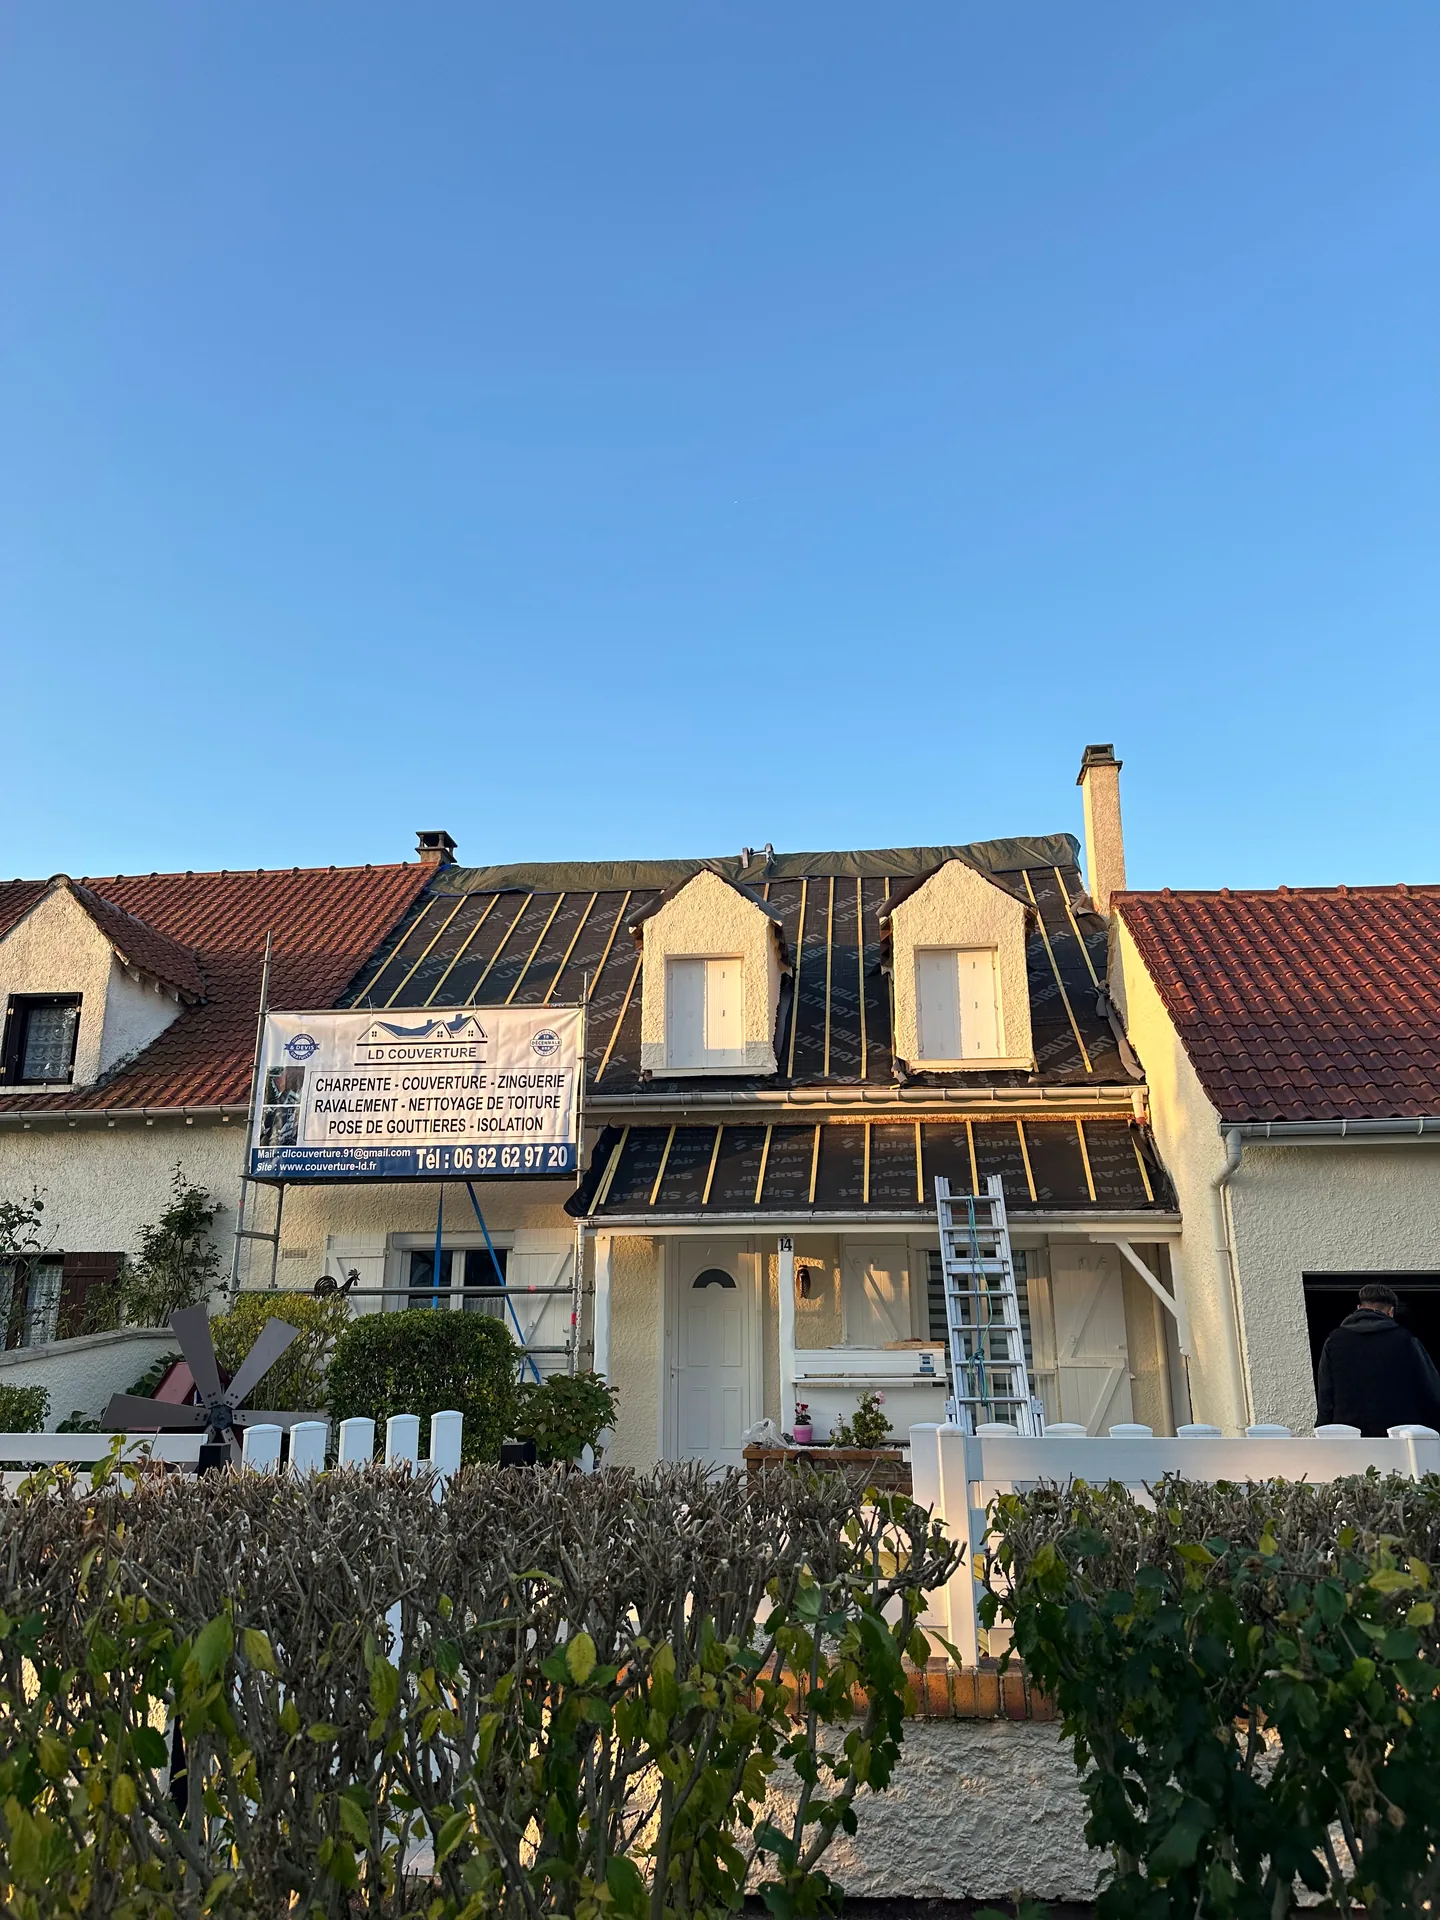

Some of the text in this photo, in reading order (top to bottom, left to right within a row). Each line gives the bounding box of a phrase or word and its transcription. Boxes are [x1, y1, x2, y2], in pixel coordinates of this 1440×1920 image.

[516, 909, 579, 935] ULTBAT
[809, 981, 879, 1009] UTIBAT
[368, 1047, 477, 1060] LD COUVERTURE
[1036, 1028, 1090, 1065] ULTIBA
[1050, 1035, 1117, 1075] ULTBAT
[315, 1077, 392, 1092] CHARPENTE
[402, 1075, 487, 1091] COUVERTURE
[497, 1074, 565, 1089] ZINGUERIE
[314, 1098, 399, 1113] RAVALEMENT
[408, 1097, 484, 1112] NETTOYAGE
[487, 1096, 504, 1110] DE
[507, 1095, 562, 1110] TOITURE
[328, 1120, 363, 1135] POSE
[366, 1119, 383, 1134] DE
[386, 1118, 466, 1134] GOUTTIERES
[477, 1116, 544, 1132] ISOLATION
[257, 1149, 275, 1159] Mail
[281, 1148, 411, 1160] dlcouverture.91@gmail.com
[751, 1141, 815, 1153] Splast
[416, 1147, 440, 1170] Tél
[453, 1148, 473, 1169] 06
[477, 1147, 497, 1168] 82
[501, 1146, 521, 1168] 62
[524, 1146, 544, 1168] 97
[547, 1145, 568, 1167] 20
[256, 1162, 273, 1172] Site
[279, 1161, 377, 1172] www.couverture-ld.fr
[612, 1191, 681, 1202] Silast
[724, 1187, 795, 1199] Sipast
[838, 1186, 912, 1197] Siplst
[779, 1238, 793, 1252] 14
